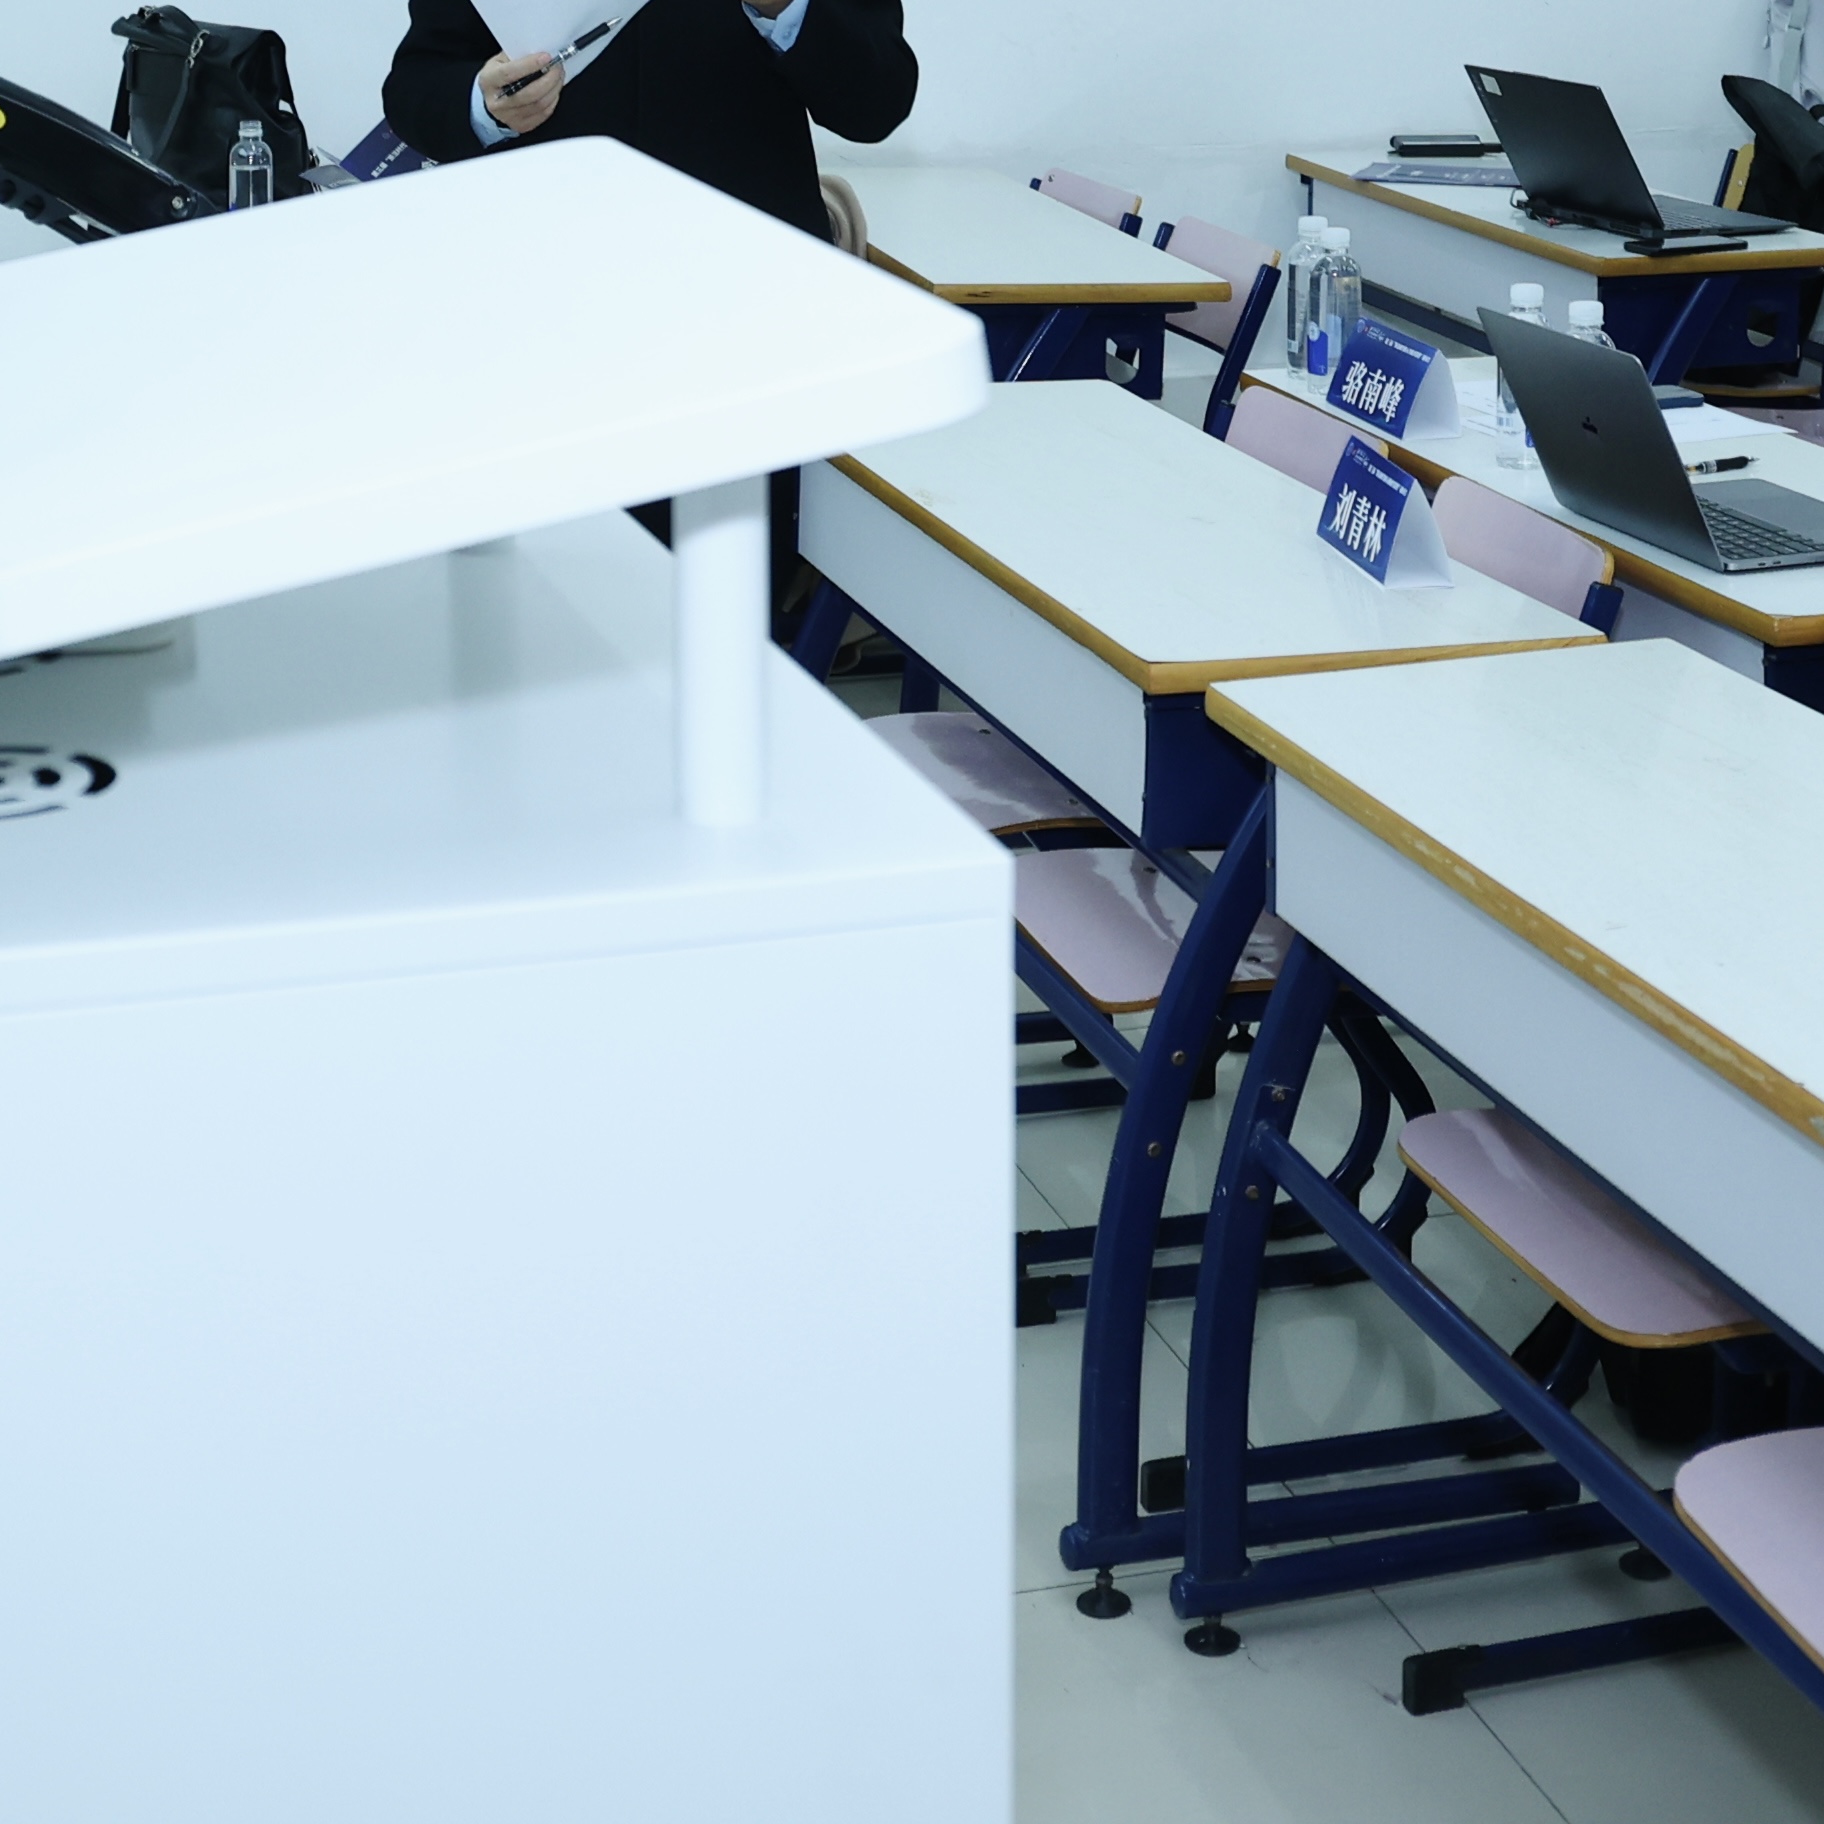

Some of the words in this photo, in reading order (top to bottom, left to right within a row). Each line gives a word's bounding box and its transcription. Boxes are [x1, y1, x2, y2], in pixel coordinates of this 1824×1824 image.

[1341, 360, 1405, 423] 骆南峰
[1328, 482, 1387, 563] 刘青林
